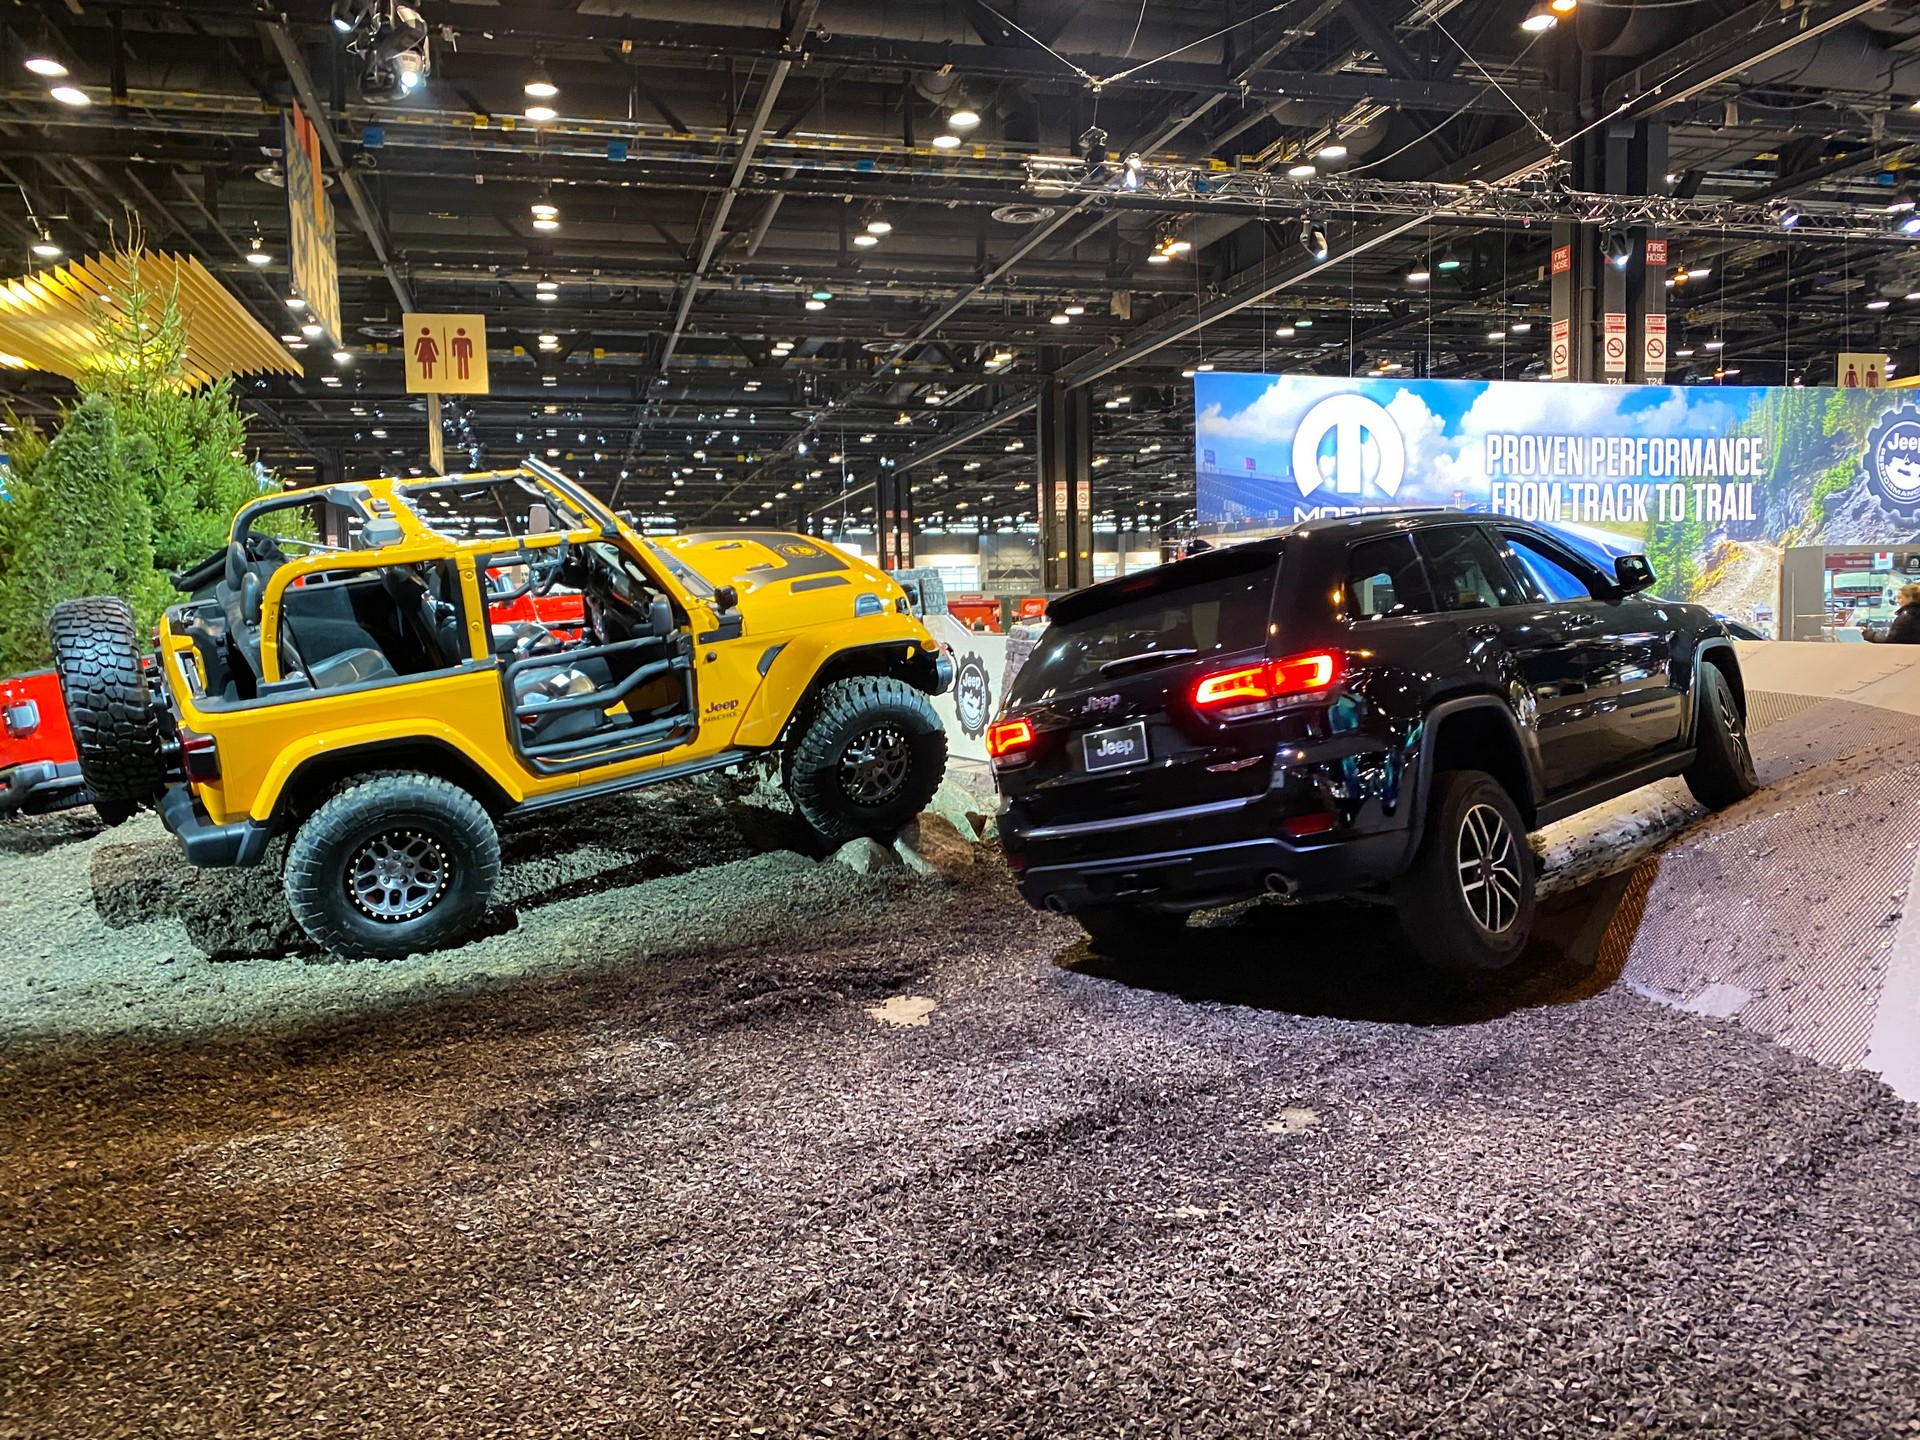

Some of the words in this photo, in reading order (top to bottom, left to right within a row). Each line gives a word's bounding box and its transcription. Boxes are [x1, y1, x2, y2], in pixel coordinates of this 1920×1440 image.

[1647, 242, 1664, 252] FIRE
[1554, 249, 1567, 261] FIRE
[1646, 253, 1666, 262] HOSE
[1553, 258, 1569, 271] HOSE
[1606, 377, 1623, 385] T24
[1647, 377, 1663, 385] T24
[1486, 434, 1583, 475] PROVEN
[1591, 437, 1763, 476] PERFORMANCE
[1492, 481, 1562, 522] FROM
[1569, 482, 1650, 522] TRACK
[1655, 482, 1686, 522] TO
[1693, 482, 1757, 521] TRAIL
[962, 672, 981, 691] Jeep
[705, 699, 739, 714] Jeep
[1082, 694, 1120, 713] Jeep
[1096, 738, 1134, 757] Jeep
